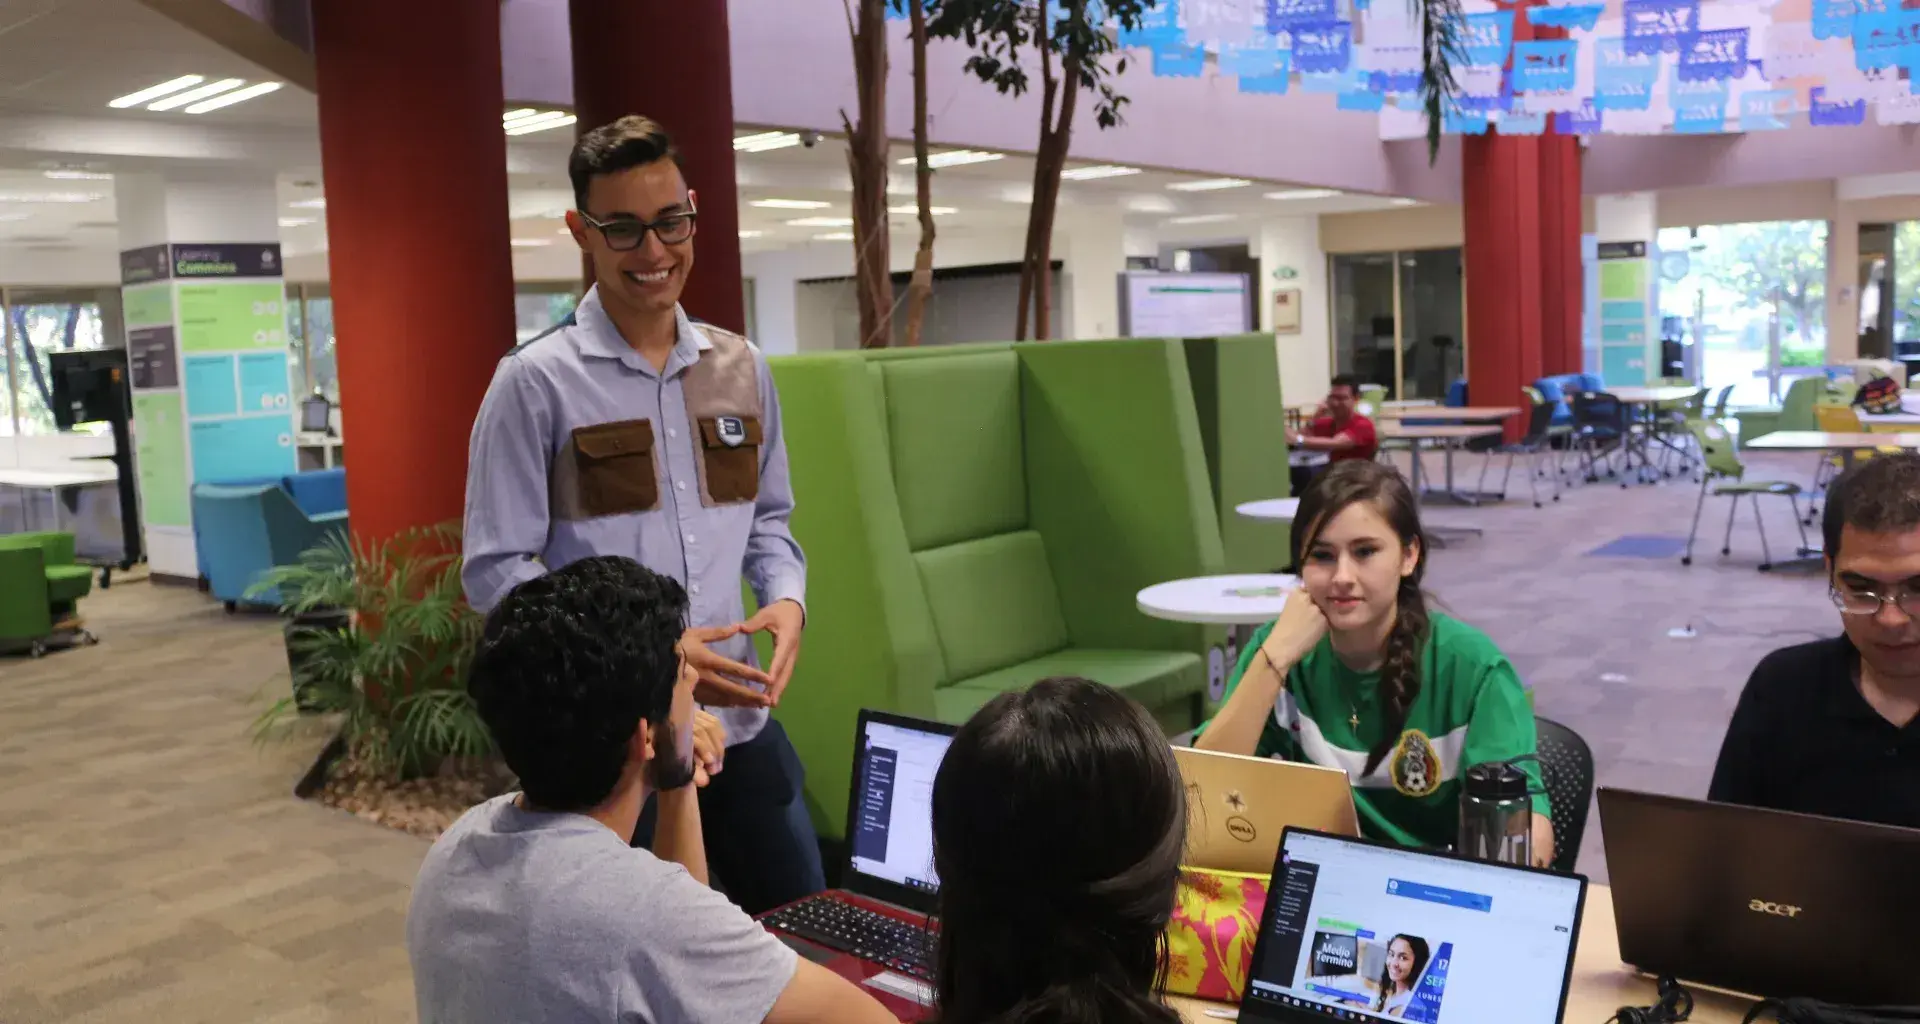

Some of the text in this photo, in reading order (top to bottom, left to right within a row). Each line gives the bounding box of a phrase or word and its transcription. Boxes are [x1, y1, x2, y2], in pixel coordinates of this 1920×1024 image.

[1748, 899, 1802, 917] acer
[1322, 942, 1351, 958] Medio
[1438, 958, 1449, 970] 17
